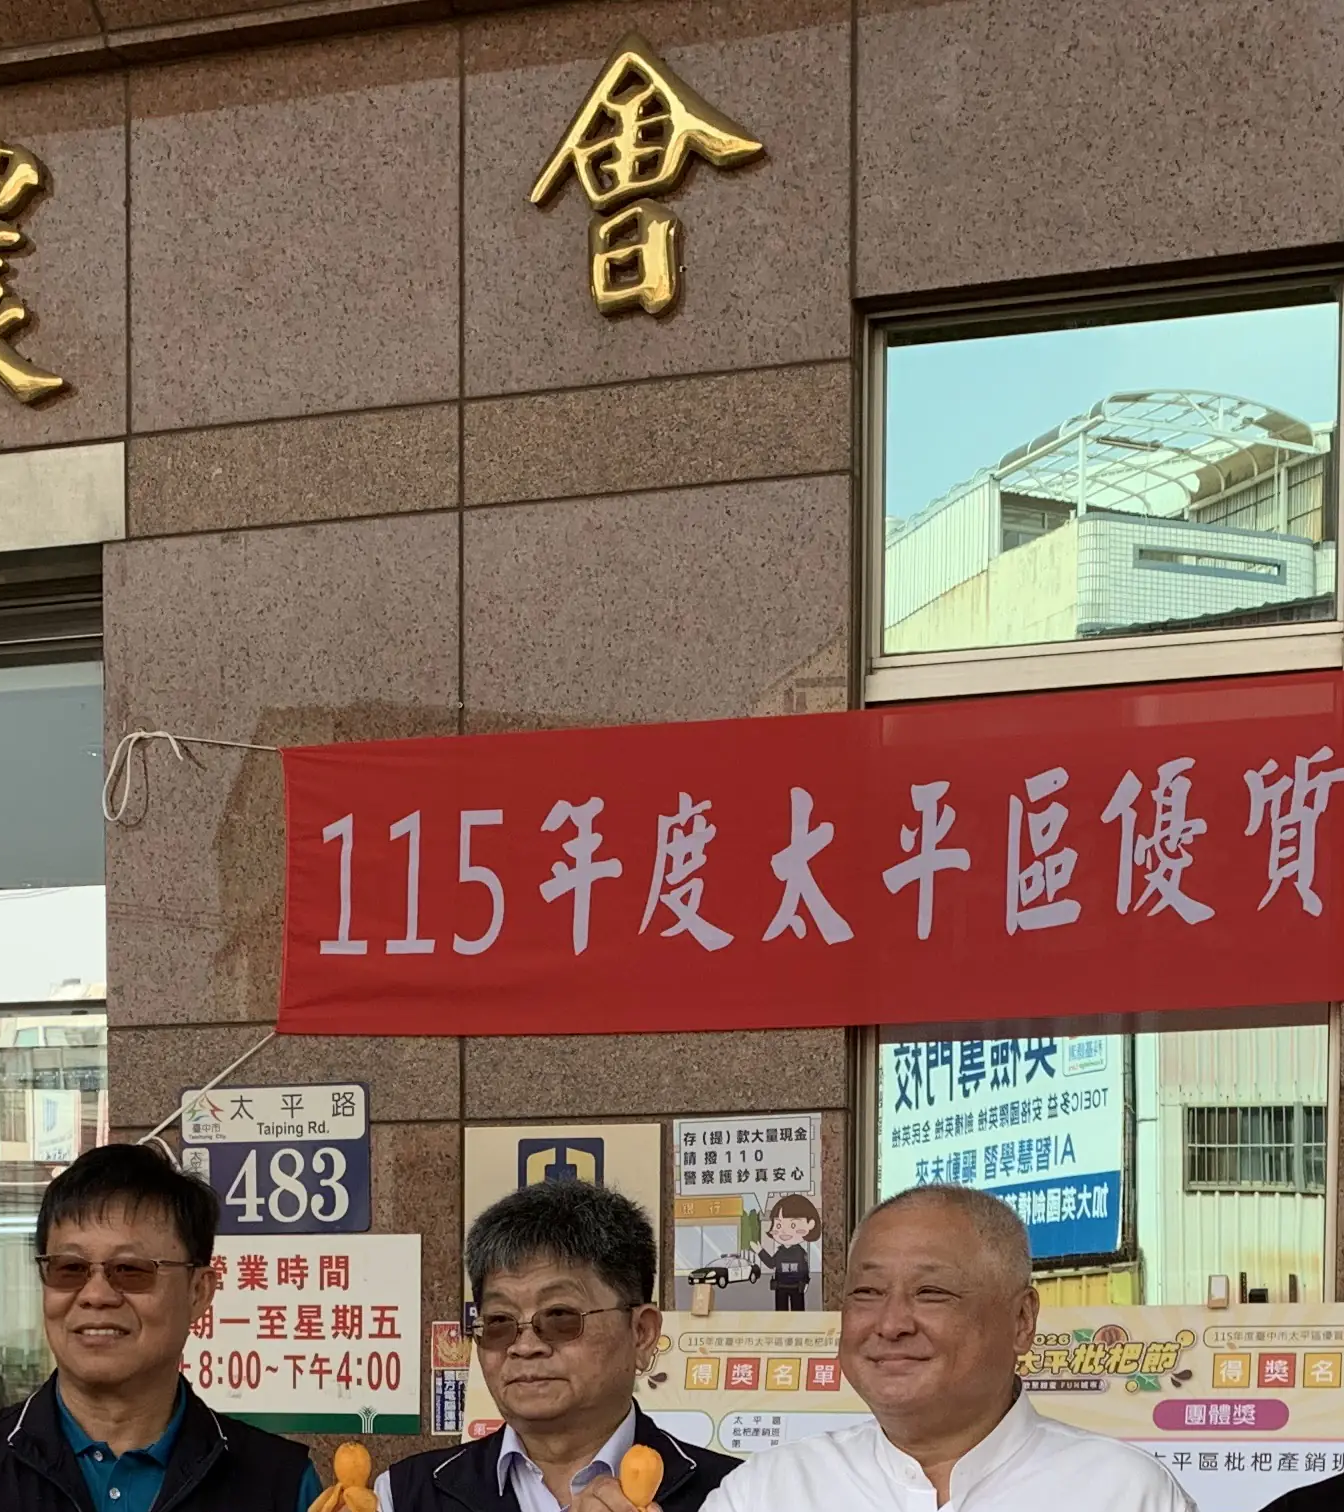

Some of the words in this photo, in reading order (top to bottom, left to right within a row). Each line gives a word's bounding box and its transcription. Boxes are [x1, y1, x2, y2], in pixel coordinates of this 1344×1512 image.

[230, 1092, 356, 1121] 太平路
[257, 1122, 304, 1138] Taiping
[308, 1120, 330, 1134] Rd.
[225, 1147, 350, 1223] 483
[684, 1167, 805, 1185] 警察護鈔真安心
[1035, 1334, 1071, 1346] 026
[1017, 1342, 1181, 1375] 太平枇杷節
[692, 1364, 836, 1386] 得獎名單
[1185, 1404, 1256, 1425] 團體獎
[732, 1427, 780, 1437] 枇杷產銷班
